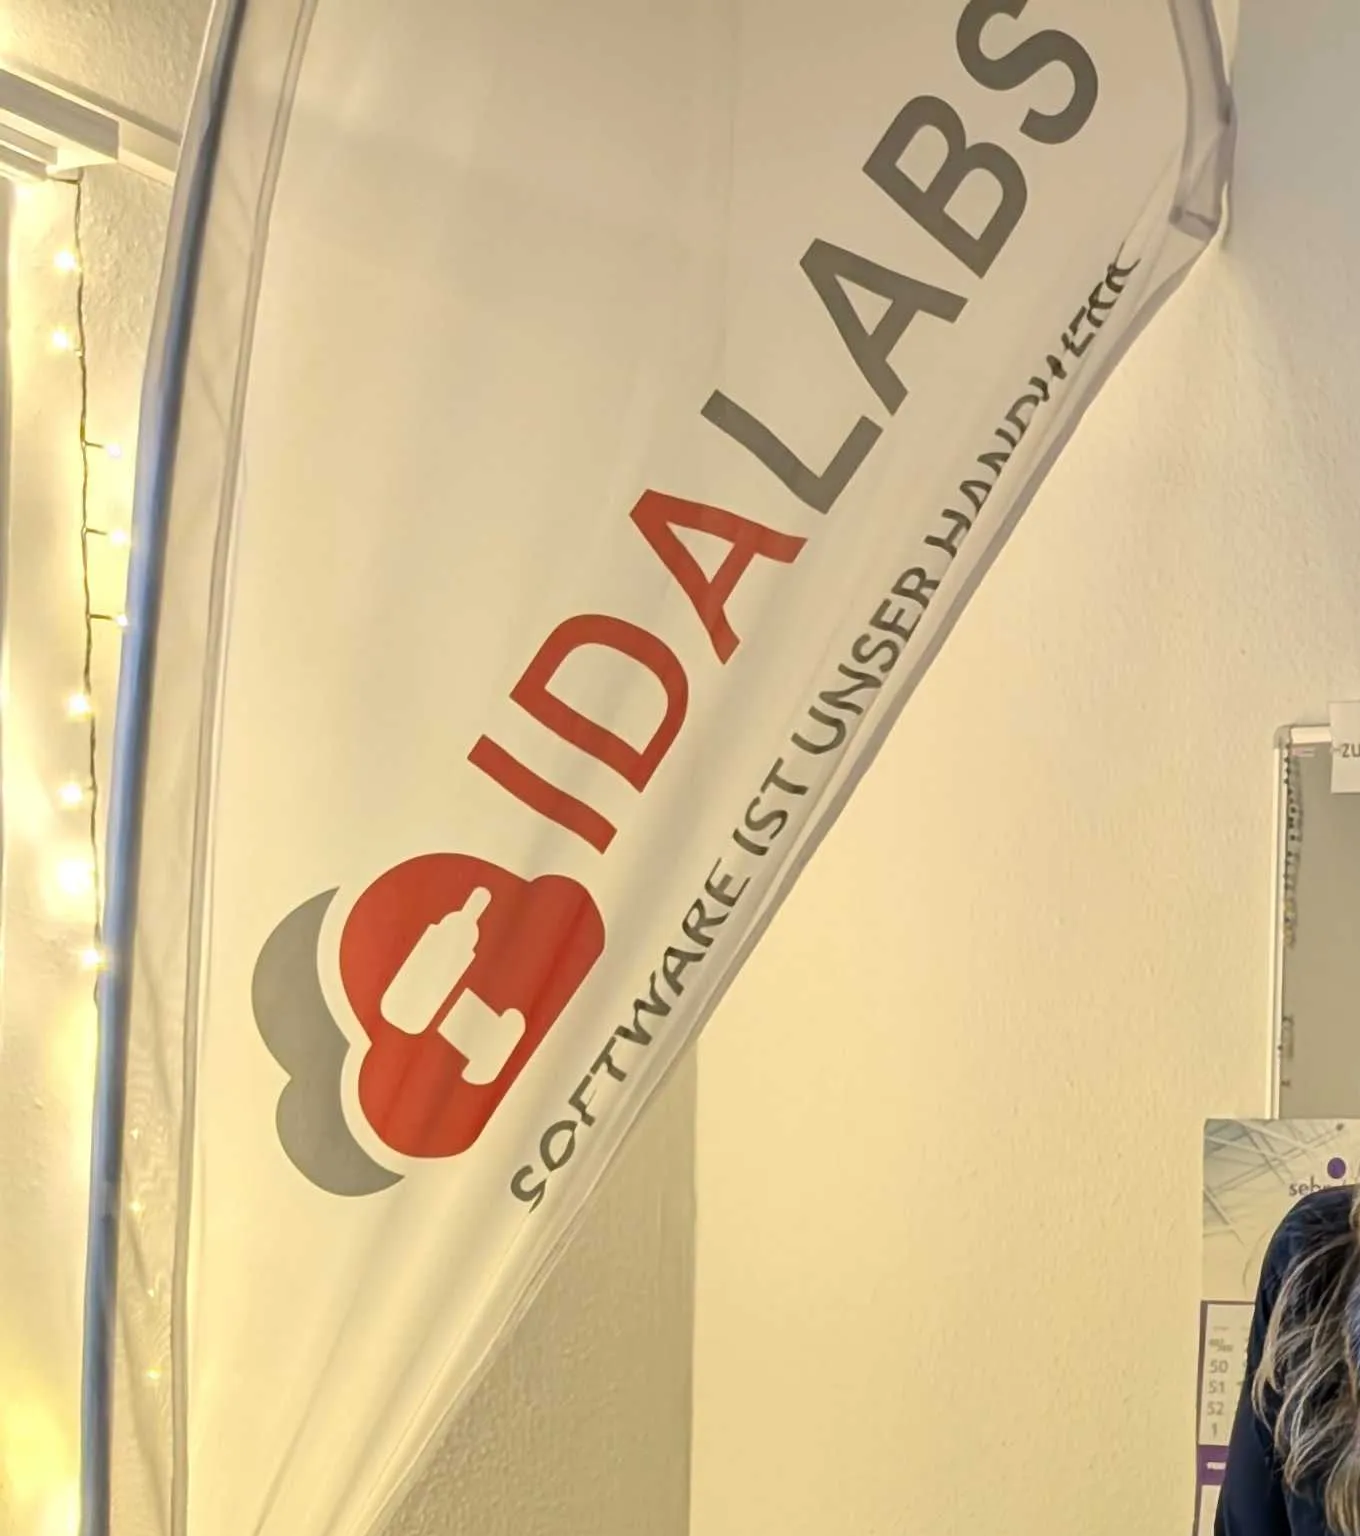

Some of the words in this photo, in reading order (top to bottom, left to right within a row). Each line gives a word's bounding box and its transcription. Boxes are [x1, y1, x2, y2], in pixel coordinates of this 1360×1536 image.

[467, 0, 1099, 854] IDALABS
[510, 857, 751, 1213] SOFTWARE
[732, 757, 809, 856] IST
[791, 566, 941, 755] UNSER
